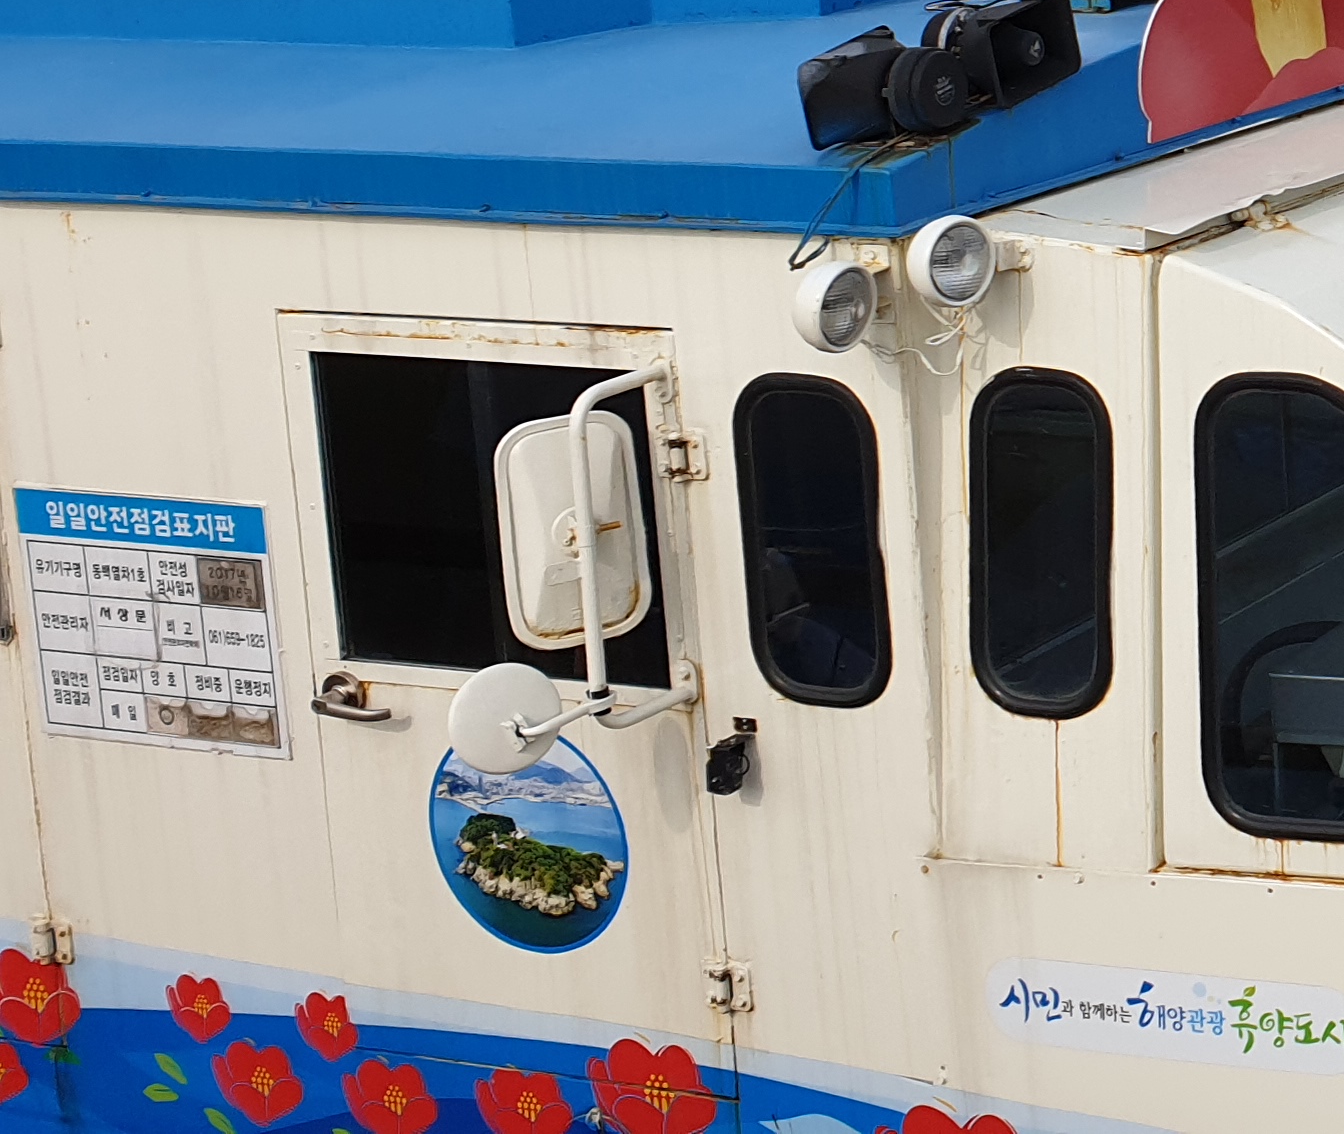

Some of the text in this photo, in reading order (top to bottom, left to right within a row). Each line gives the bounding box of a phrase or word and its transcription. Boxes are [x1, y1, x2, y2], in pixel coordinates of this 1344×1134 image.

[45, 500, 236, 543] 일일안전점검표지판
[36, 558, 82, 578] 유기기구명
[158, 560, 187, 578] 안전성
[156, 578, 194, 598] 검사일자
[41, 612, 89, 632] 안전관리자
[51, 669, 89, 688] 일일안전
[102, 665, 138, 684] 점검일자
[194, 674, 223, 693] 정비중
[53, 688, 91, 707] 점검결과
[1000, 977, 1074, 1023] 시민과
[1079, 1000, 1133, 1025] 함께하는
[1127, 980, 1226, 1036] 해양관광
